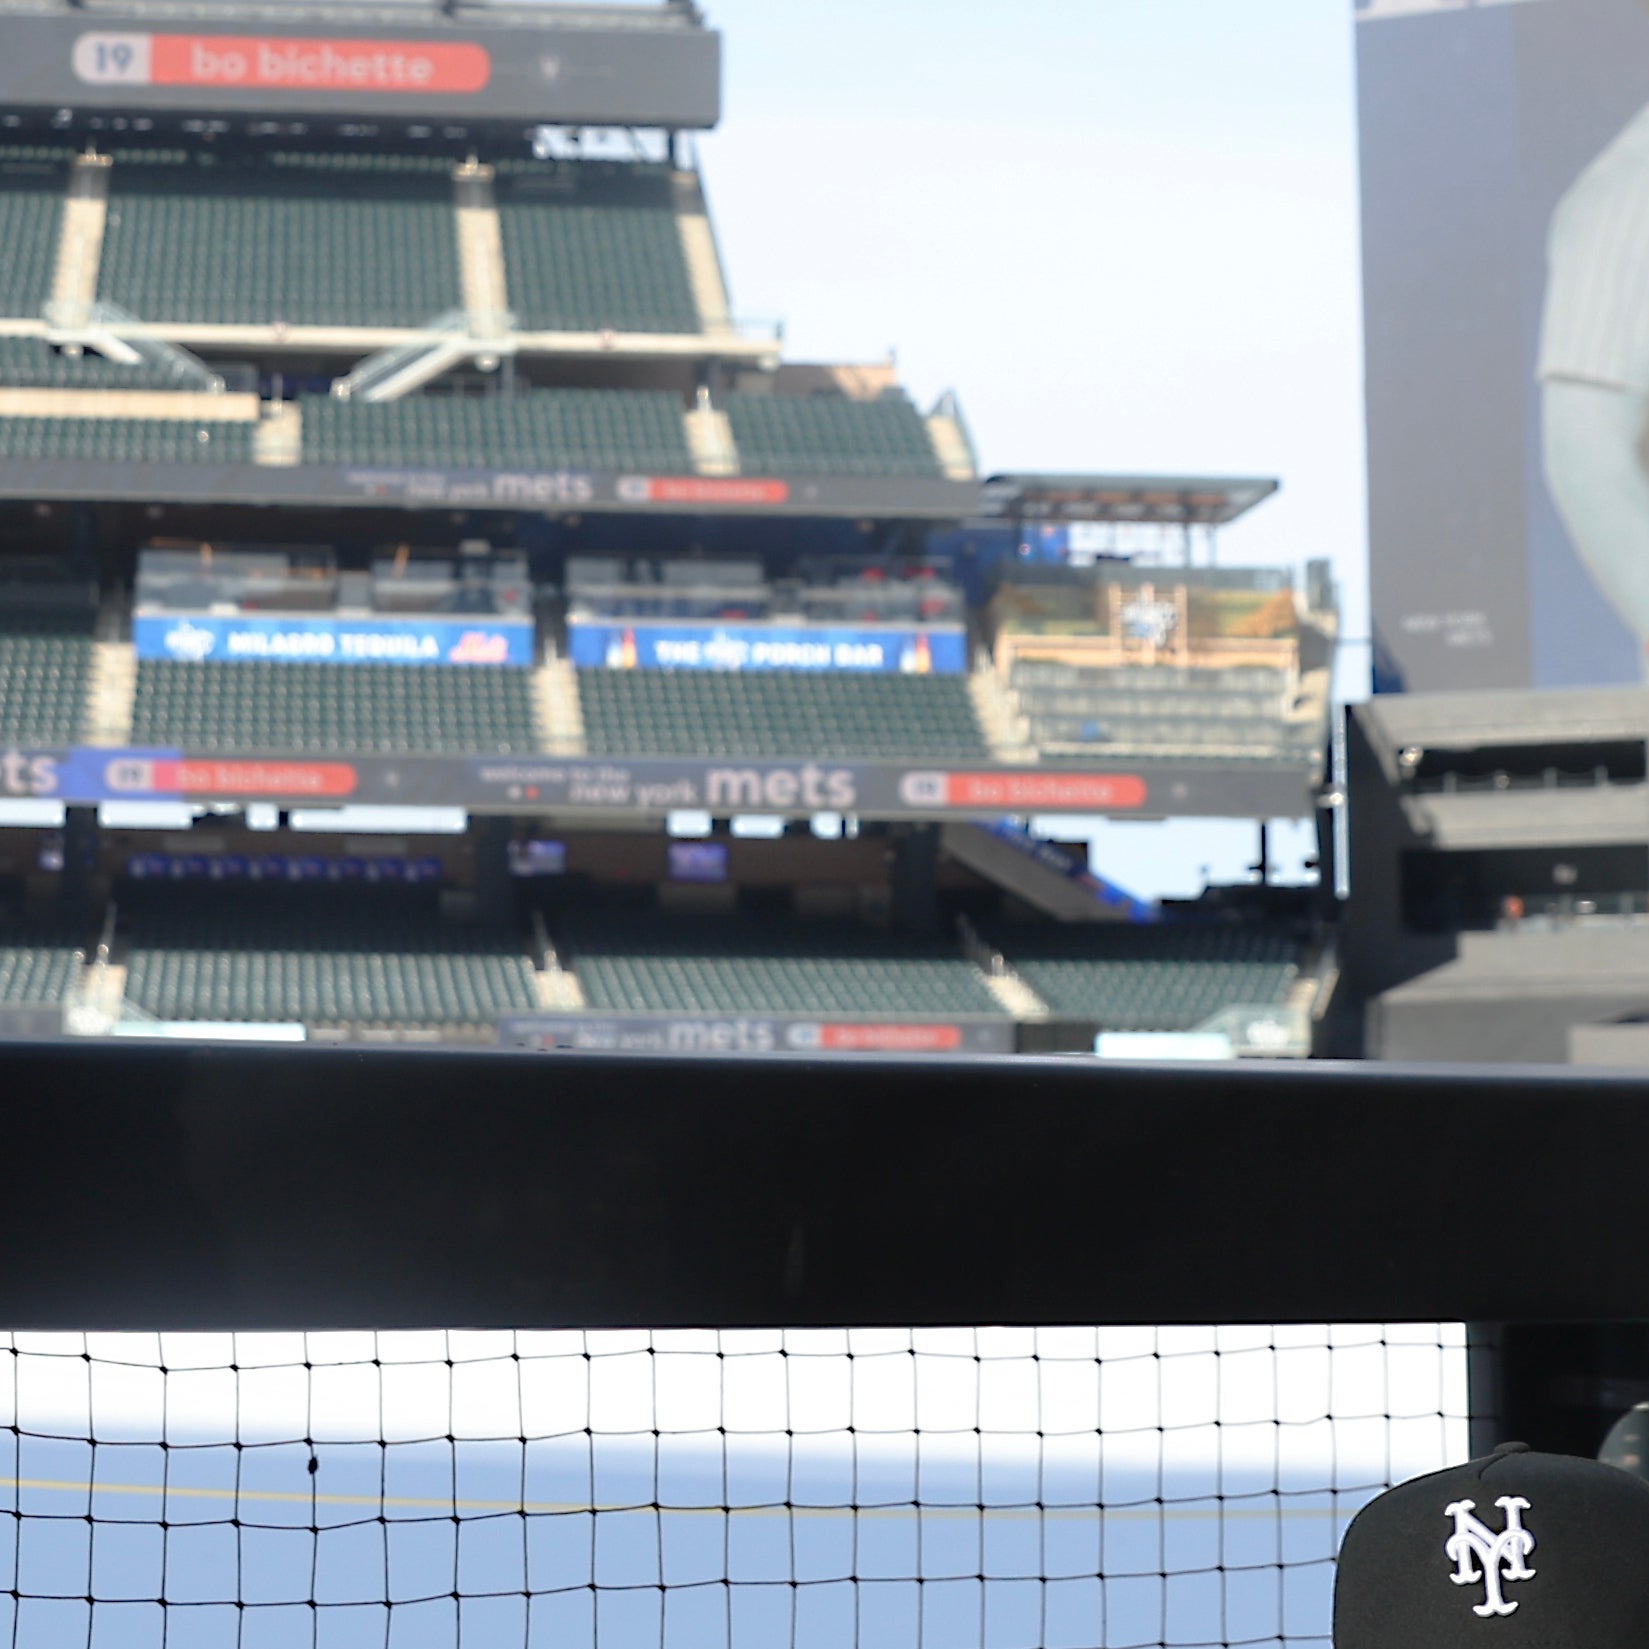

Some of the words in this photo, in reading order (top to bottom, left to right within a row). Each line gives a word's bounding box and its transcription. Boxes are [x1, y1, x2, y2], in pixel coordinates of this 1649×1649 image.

[94, 42, 134, 75] 19
[192, 44, 246, 78] bo
[258, 43, 434, 85] bichette
[655, 639, 700, 665] THE
[834, 642, 885, 667] BAR
[706, 763, 856, 807] mets
